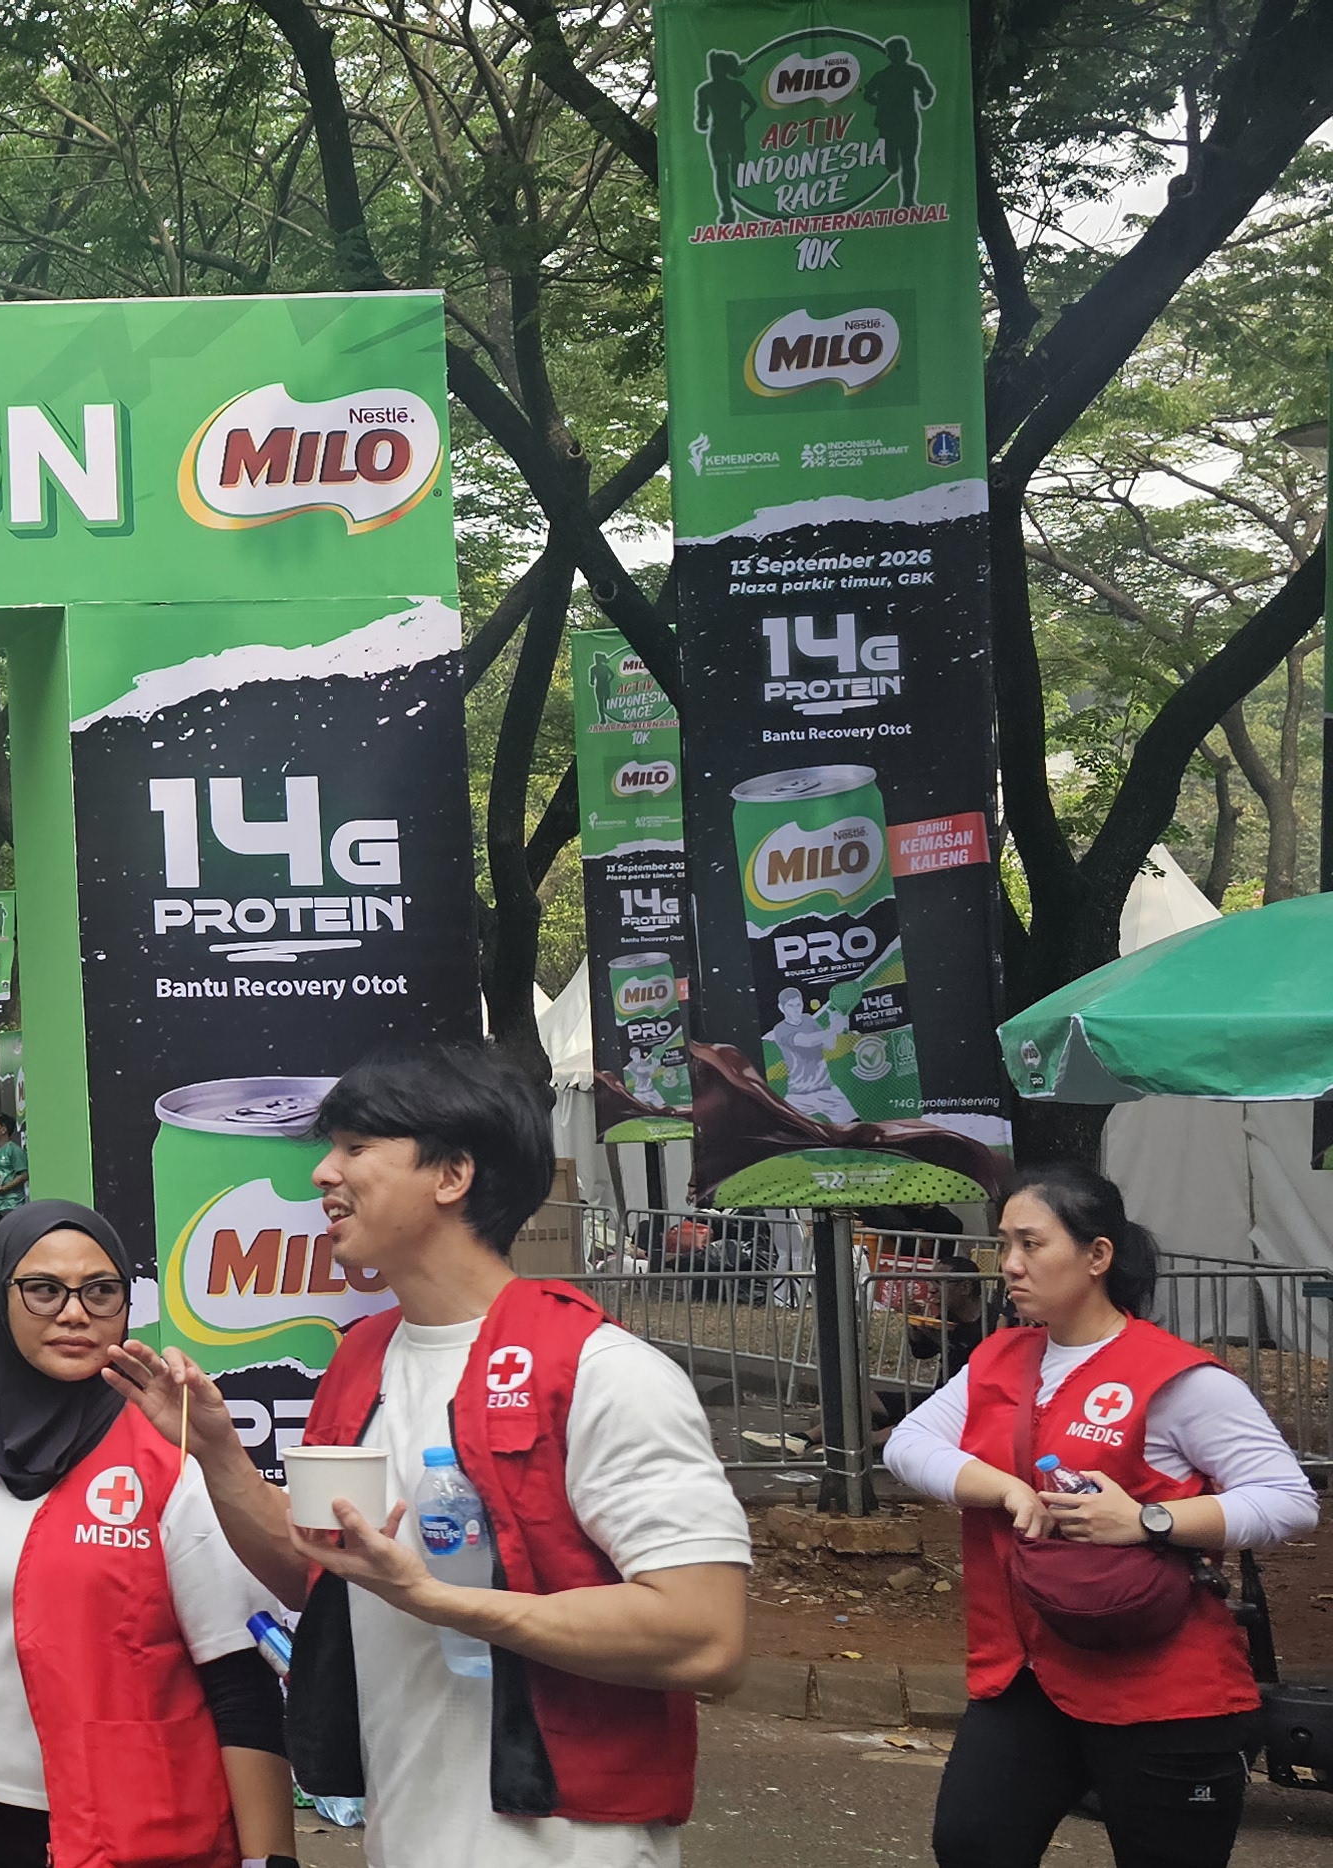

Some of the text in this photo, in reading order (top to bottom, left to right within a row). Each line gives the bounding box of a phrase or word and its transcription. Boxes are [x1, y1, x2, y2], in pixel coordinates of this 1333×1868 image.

[775, 67, 851, 94] MILO
[761, 113, 856, 151] ACTIV
[736, 138, 886, 188] INDONESIA
[774, 174, 848, 214] RACE
[690, 203, 950, 243] JAKARTA INTERNATIONAL
[795, 237, 843, 271] 10K
[768, 331, 884, 373] MILO
[219, 427, 413, 489] MILO
[827, 439, 883, 452] INDONESIA
[828, 446, 910, 461] SPORTS SUMMIT
[705, 452, 781, 467] KEMENPORA
[828, 458, 863, 469] 2026
[731, 549, 934, 579] 13 September 2026
[729, 571, 935, 595] Plaza parkir timur, GBK
[762, 613, 900, 678] 14G
[623, 659, 645, 671] MIL
[622, 706, 653, 720] RACE
[631, 731, 651, 745] 10K
[762, 722, 912, 744] Bantu Recovery Otot
[620, 771, 669, 787] MILO
[149, 776, 401, 889] 14G
[917, 819, 953, 836] BARU!
[899, 829, 974, 855] KEMASAN
[618, 861, 667, 873] September
[669, 861, 685, 870] 202
[767, 840, 871, 887] MILO
[909, 848, 969, 873] KALENG
[620, 888, 680, 916] 14G
[153, 896, 404, 935] PROTEIN
[774, 926, 877, 970] PRO
[784, 959, 866, 979] SOURCE OF PROTEIN
[156, 975, 408, 1001] Bantu Recovery Otot
[624, 984, 668, 1004] MILO
[854, 1005, 904, 1022] PROTEIN
[861, 993, 895, 1010] 14G
[627, 1021, 672, 1040] PRO
[918, 1096, 1000, 1109] protein/serving
[486, 1392, 531, 1409] EDIS
[1065, 1421, 1125, 1447] MEDIS
[74, 1524, 152, 1550] MEDIS
